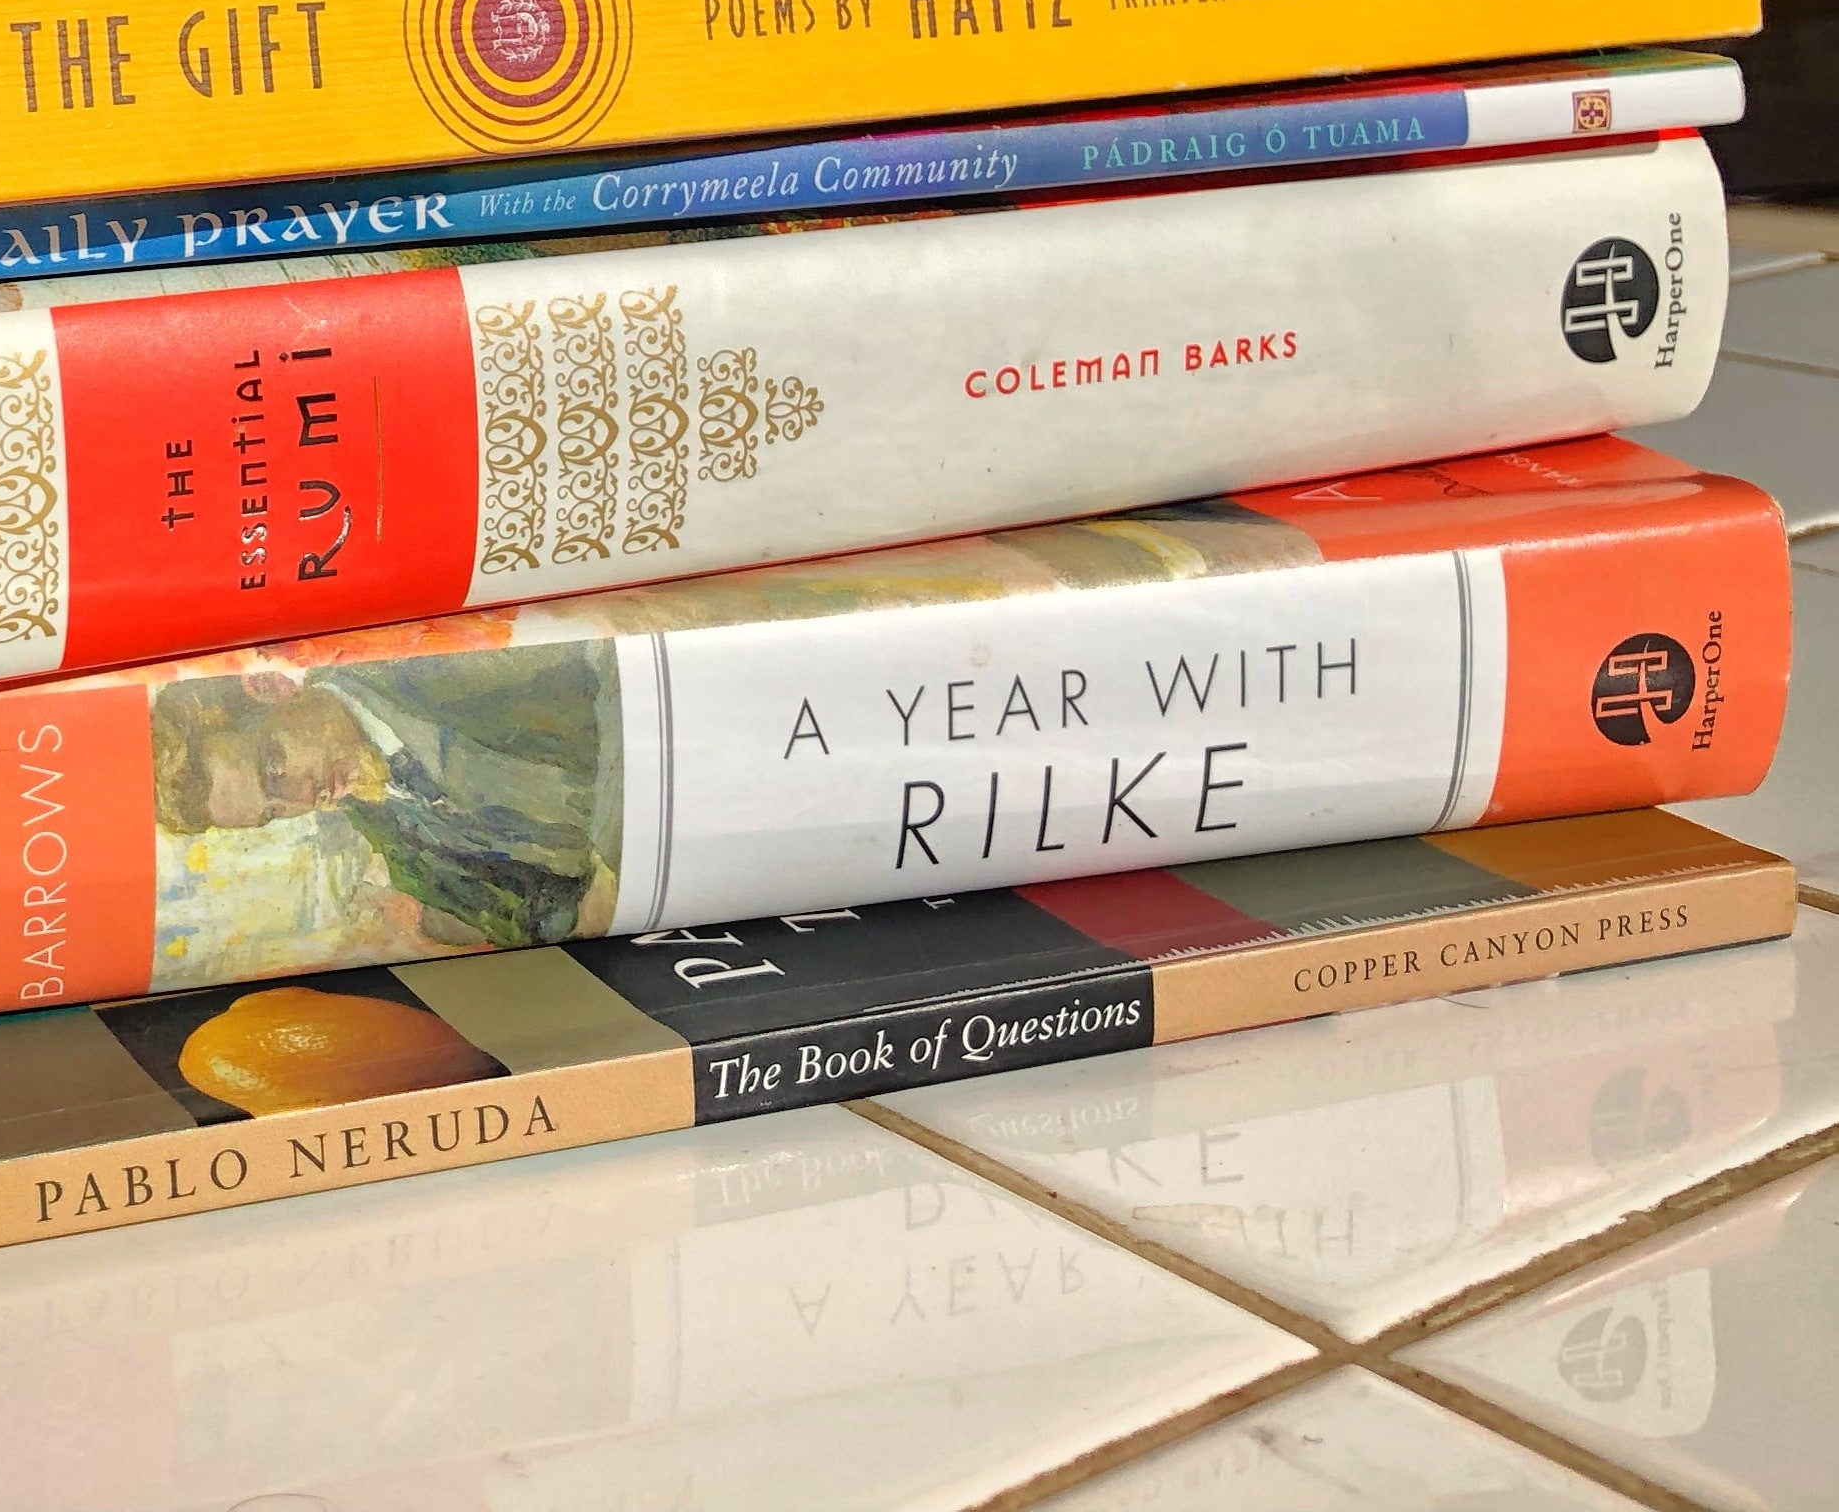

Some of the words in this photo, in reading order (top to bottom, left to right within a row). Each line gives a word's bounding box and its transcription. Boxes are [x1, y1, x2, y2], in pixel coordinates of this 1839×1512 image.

[10, 15, 136, 113] THE
[178, 0, 326, 100] GIFT
[477, 191, 537, 219] With
[544, 189, 578, 215] the
[593, 160, 800, 216] Corrymeela
[812, 148, 1019, 194] Community
[1081, 130, 1247, 171] PÁDRAIG
[1266, 122, 1286, 154] Ó
[1303, 115, 1425, 152] TUAMA
[1654, 211, 1687, 372] HarperOne
[965, 348, 1161, 399] COLEMAN
[1184, 331, 1300, 373] BARKS
[784, 698, 830, 761] A
[886, 669, 1089, 746] YEAR
[1145, 637, 1357, 718] WITH
[1691, 608, 1723, 753] HarperOne
[19, 723, 68, 1000] BARROWS
[894, 742, 1249, 870] RILKE
[1294, 951, 1423, 993] COPPER
[1440, 921, 1582, 967] CANYON
[1597, 904, 1690, 942] PRESS
[708, 1056, 781, 1101] The
[795, 1030, 894, 1086] Book
[909, 1020, 953, 1072] of
[961, 996, 1142, 1064] Questions
[35, 1148, 249, 1223] PABLO
[289, 1095, 559, 1179] NERUDA
